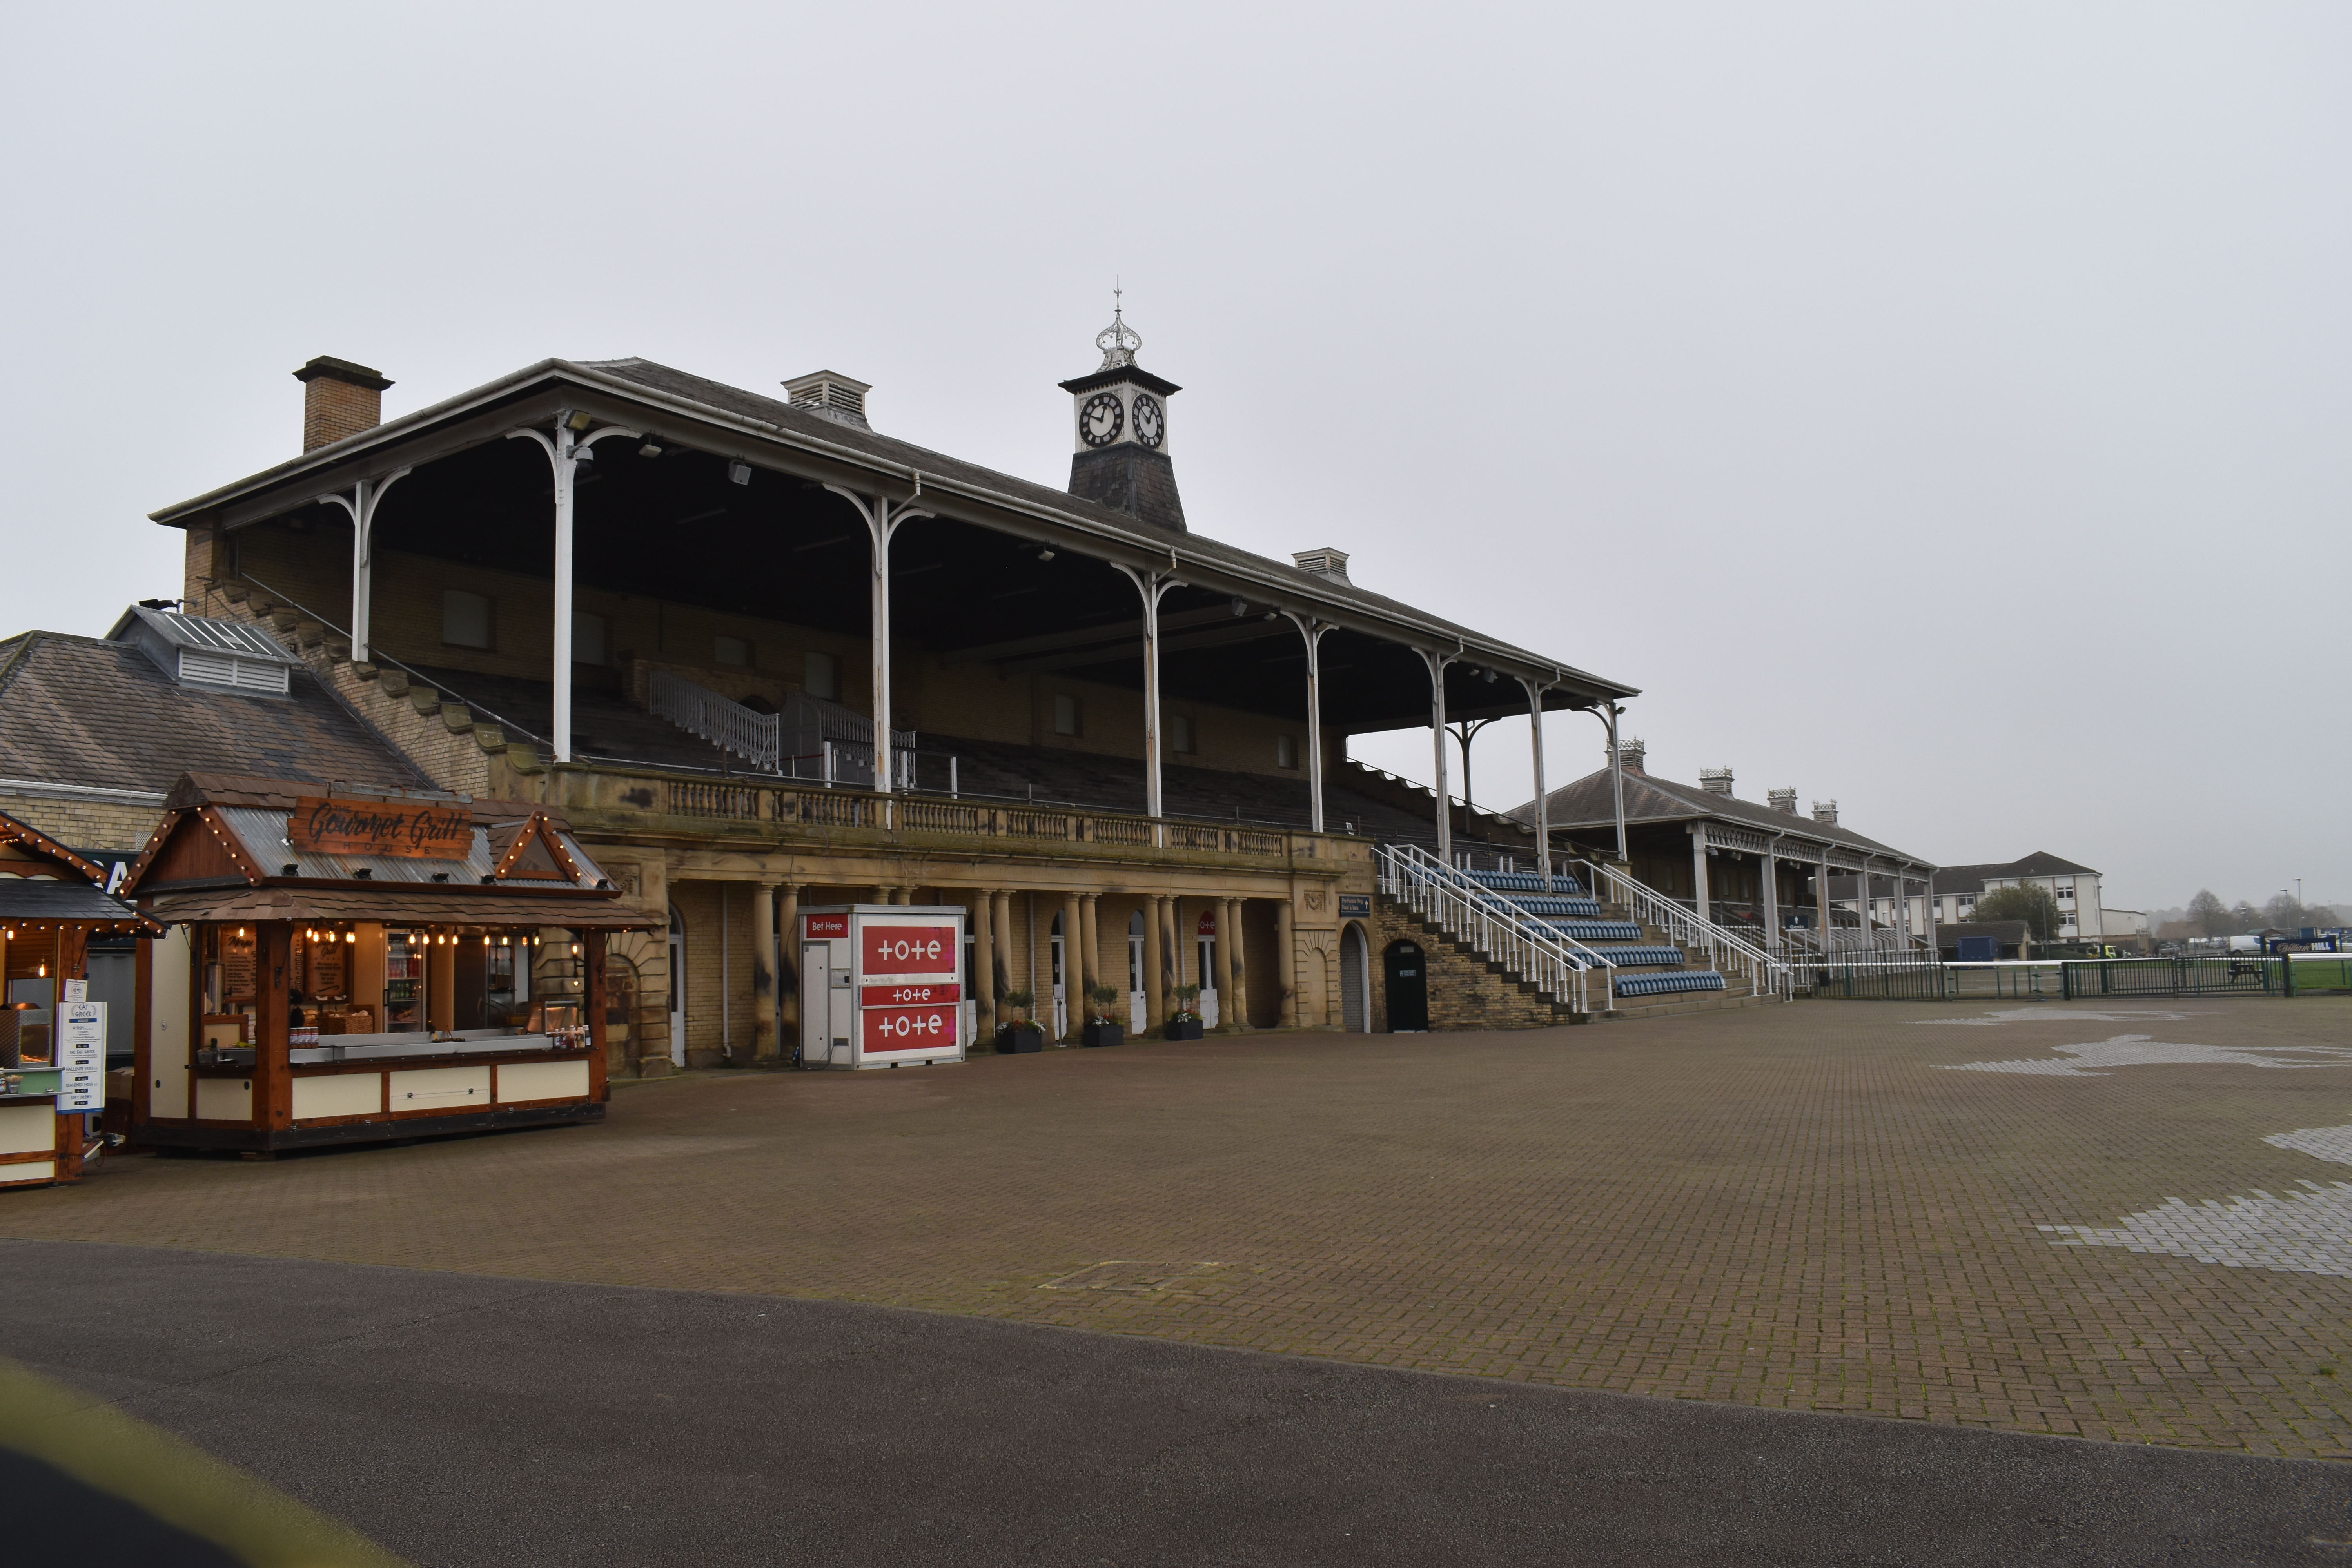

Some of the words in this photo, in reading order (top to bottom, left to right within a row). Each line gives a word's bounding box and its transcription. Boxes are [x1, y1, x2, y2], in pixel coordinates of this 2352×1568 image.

[334, 804, 351, 813] THE
[309, 802, 404, 844] Gourmet
[410, 810, 462, 850] Grill
[343, 842, 431, 854] HOUSE
[812, 922, 824, 931] Bet
[825, 921, 842, 931] Here
[1198, 921, 1215, 929] ote
[228, 935, 253, 948] Menu
[2276, 942, 2311, 953] William
[2311, 942, 2330, 951] HILL
[321, 946, 338, 957] Grill
[878, 940, 941, 960] tote
[893, 988, 931, 1002] tote
[879, 1014, 942, 1037] tote
